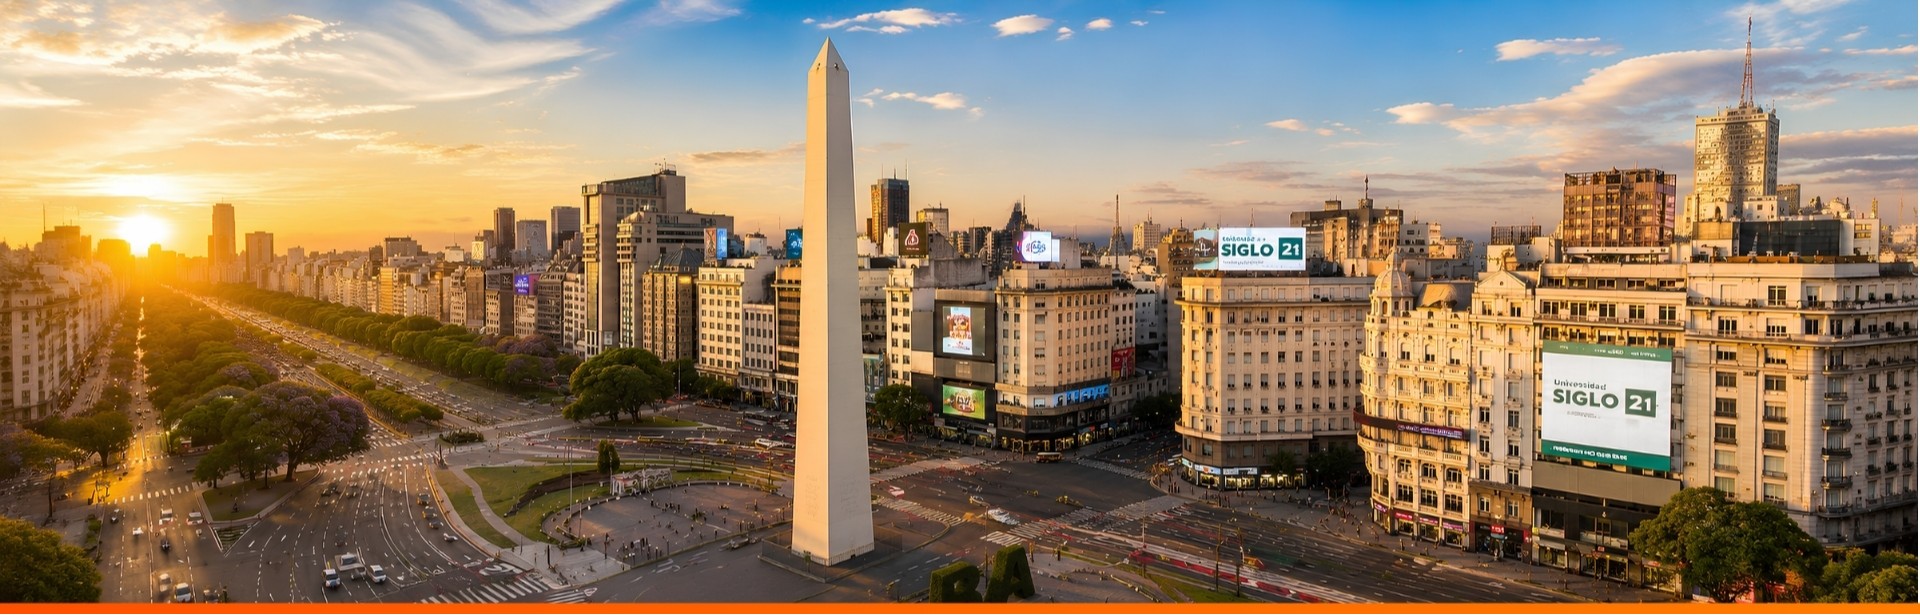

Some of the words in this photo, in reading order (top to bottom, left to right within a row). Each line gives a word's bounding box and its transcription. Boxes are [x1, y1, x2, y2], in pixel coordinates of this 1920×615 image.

[1221, 243, 1274, 257] SIGLO
[1281, 242, 1300, 256] 21
[1553, 388, 1619, 409] SIGLO
[1628, 394, 1651, 411] 21
